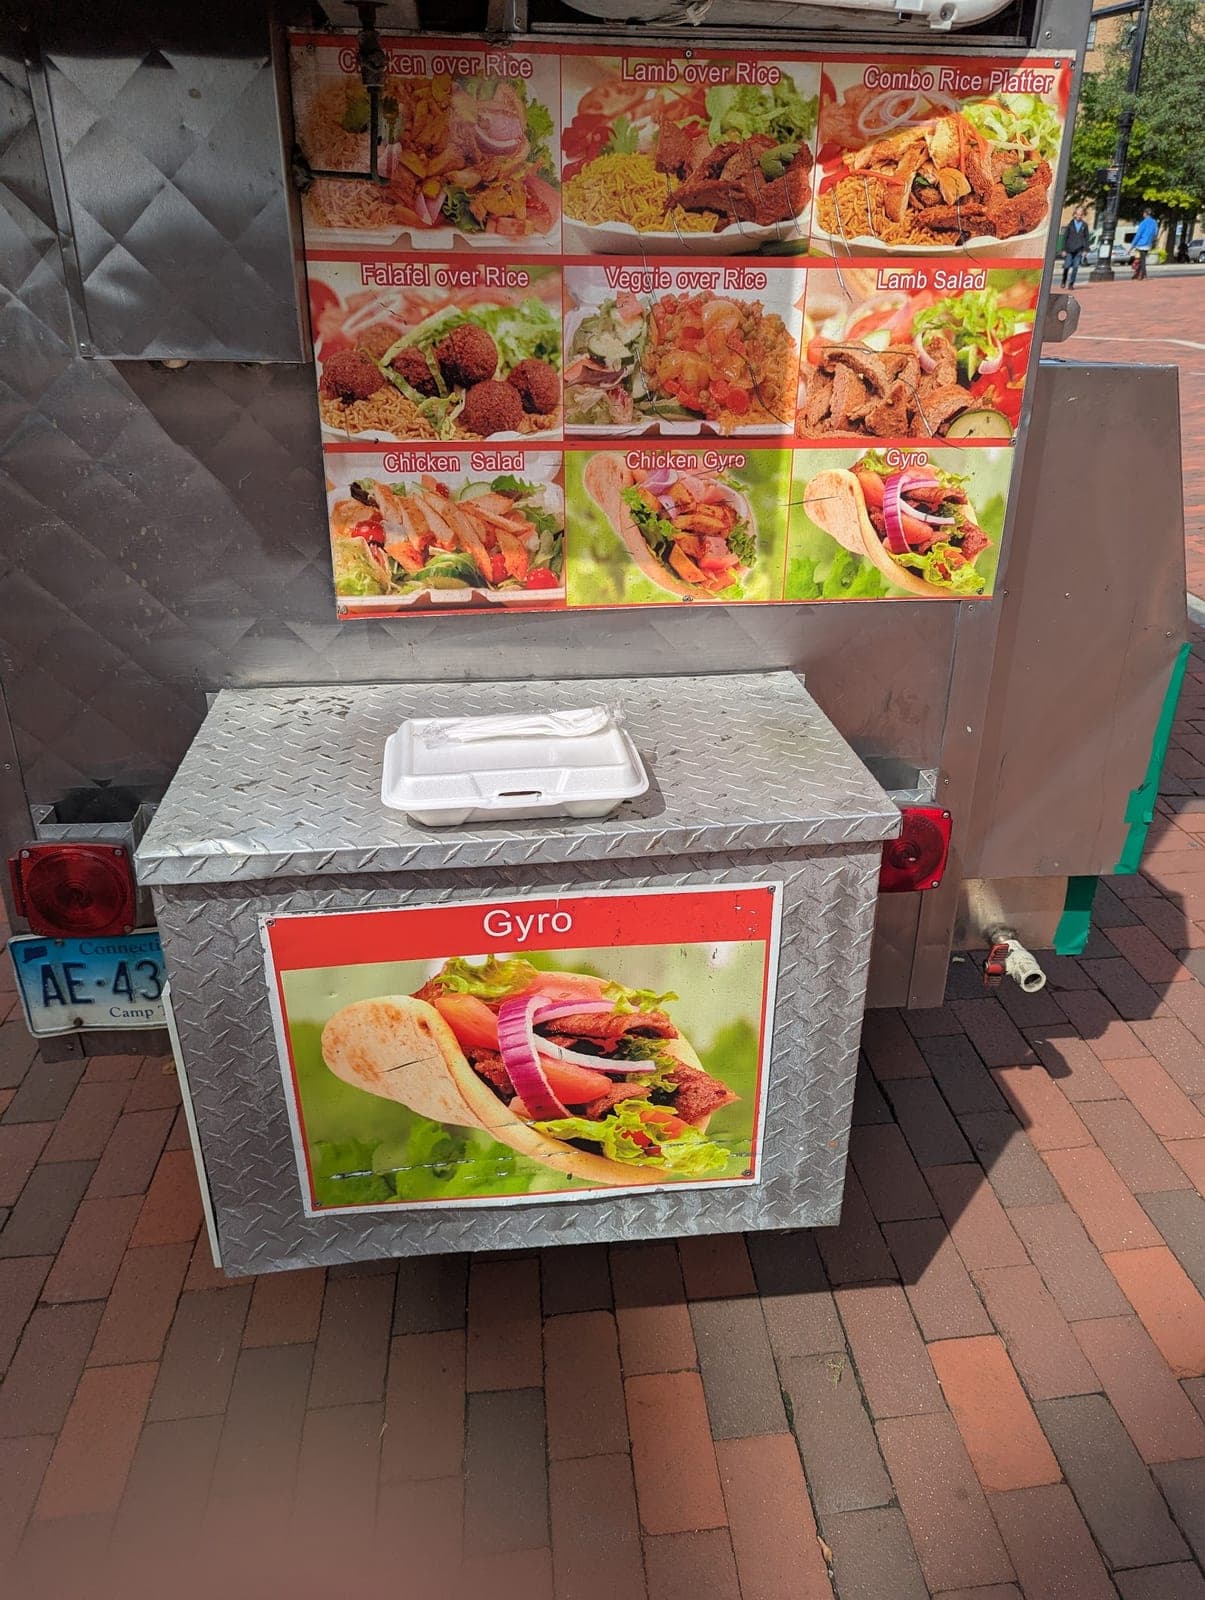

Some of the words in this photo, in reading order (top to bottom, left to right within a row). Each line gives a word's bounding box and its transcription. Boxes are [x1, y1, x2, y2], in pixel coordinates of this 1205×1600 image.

[339, 48, 426, 75] Cken
[433, 55, 480, 75] over
[486, 53, 533, 77] Rice
[622, 58, 678, 82] Lamb
[685, 65, 729, 83] over
[735, 62, 781, 84] Rice
[864, 66, 934, 91] Combo
[939, 68, 983, 92] Rice
[989, 70, 1055, 94] Platter
[361, 264, 431, 286] Falafel
[436, 268, 479, 286] over
[485, 266, 529, 287] Rice
[605, 267, 671, 292] Veggie
[676, 271, 719, 289] over
[724, 267, 767, 290] Rice
[877, 269, 928, 290] Lamb
[933, 269, 987, 290] Salad
[384, 452, 460, 472] Chicken
[471, 452, 525, 471] Salad
[626, 450, 698, 469] Chicken
[703, 450, 746, 472] Gyro
[886, 449, 928, 470] Gyro
[483, 909, 573, 942] Gyro
[109, 1006, 154, 1019] Camp
